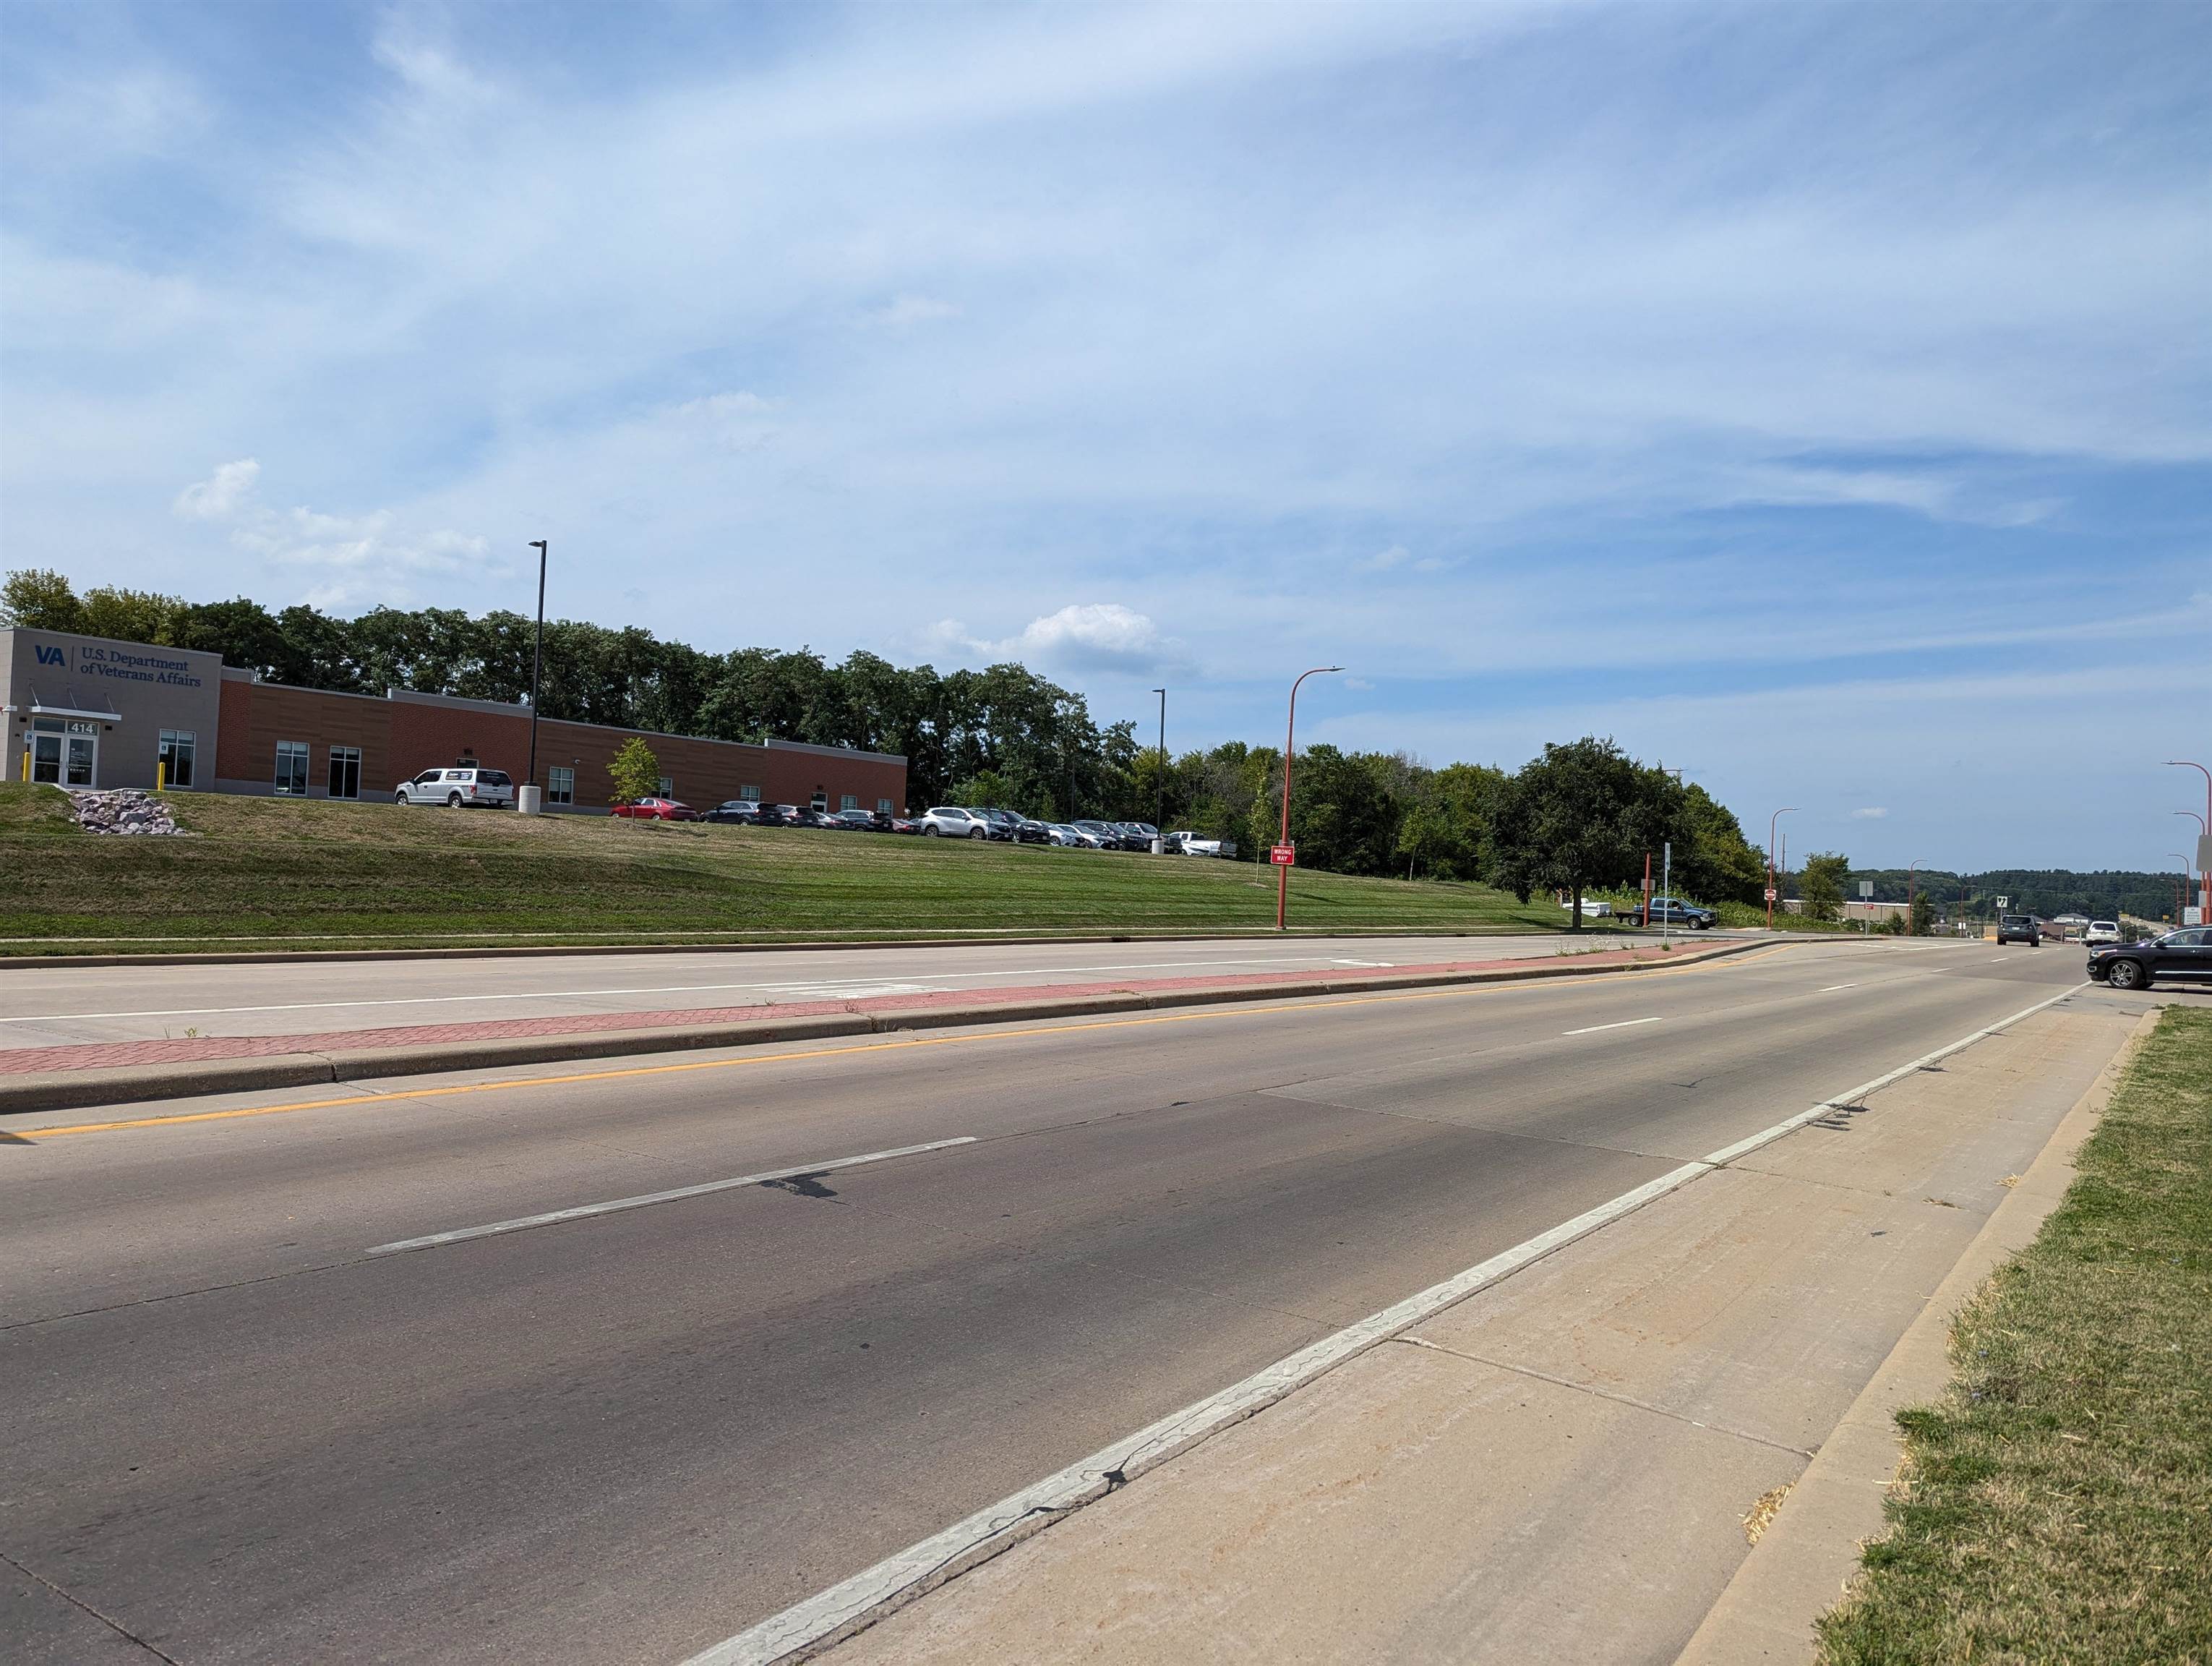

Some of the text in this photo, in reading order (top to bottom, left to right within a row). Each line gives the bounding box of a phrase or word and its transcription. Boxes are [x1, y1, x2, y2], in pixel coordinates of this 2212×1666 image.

[35, 645, 66, 667] VA
[82, 647, 189, 672] U.S. Department
[81, 662, 202, 688] of Veterans Affairs
[72, 722, 93, 734] 414
